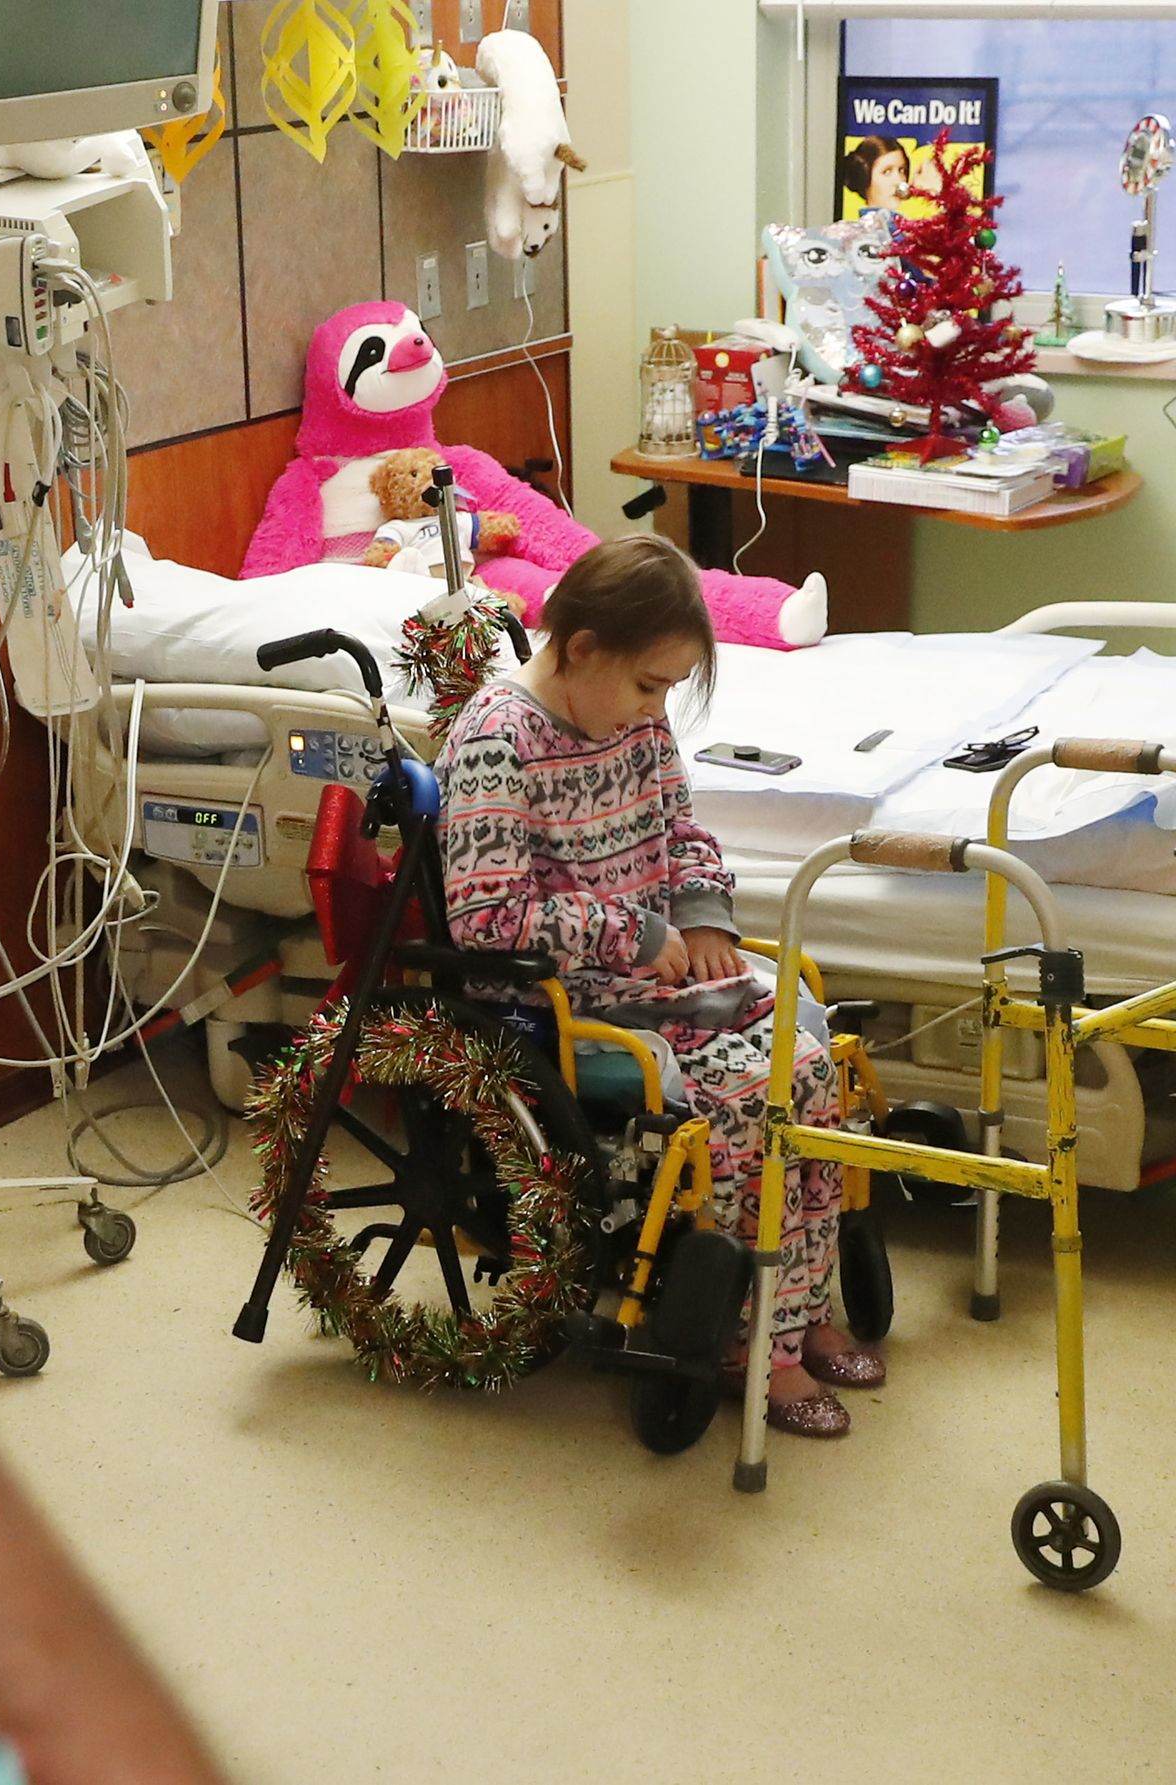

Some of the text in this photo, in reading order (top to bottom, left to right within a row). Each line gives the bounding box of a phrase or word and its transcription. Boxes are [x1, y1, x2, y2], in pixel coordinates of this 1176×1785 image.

[853, 98, 982, 125] We Can Do It!
[195, 812, 218, 824] OFF
